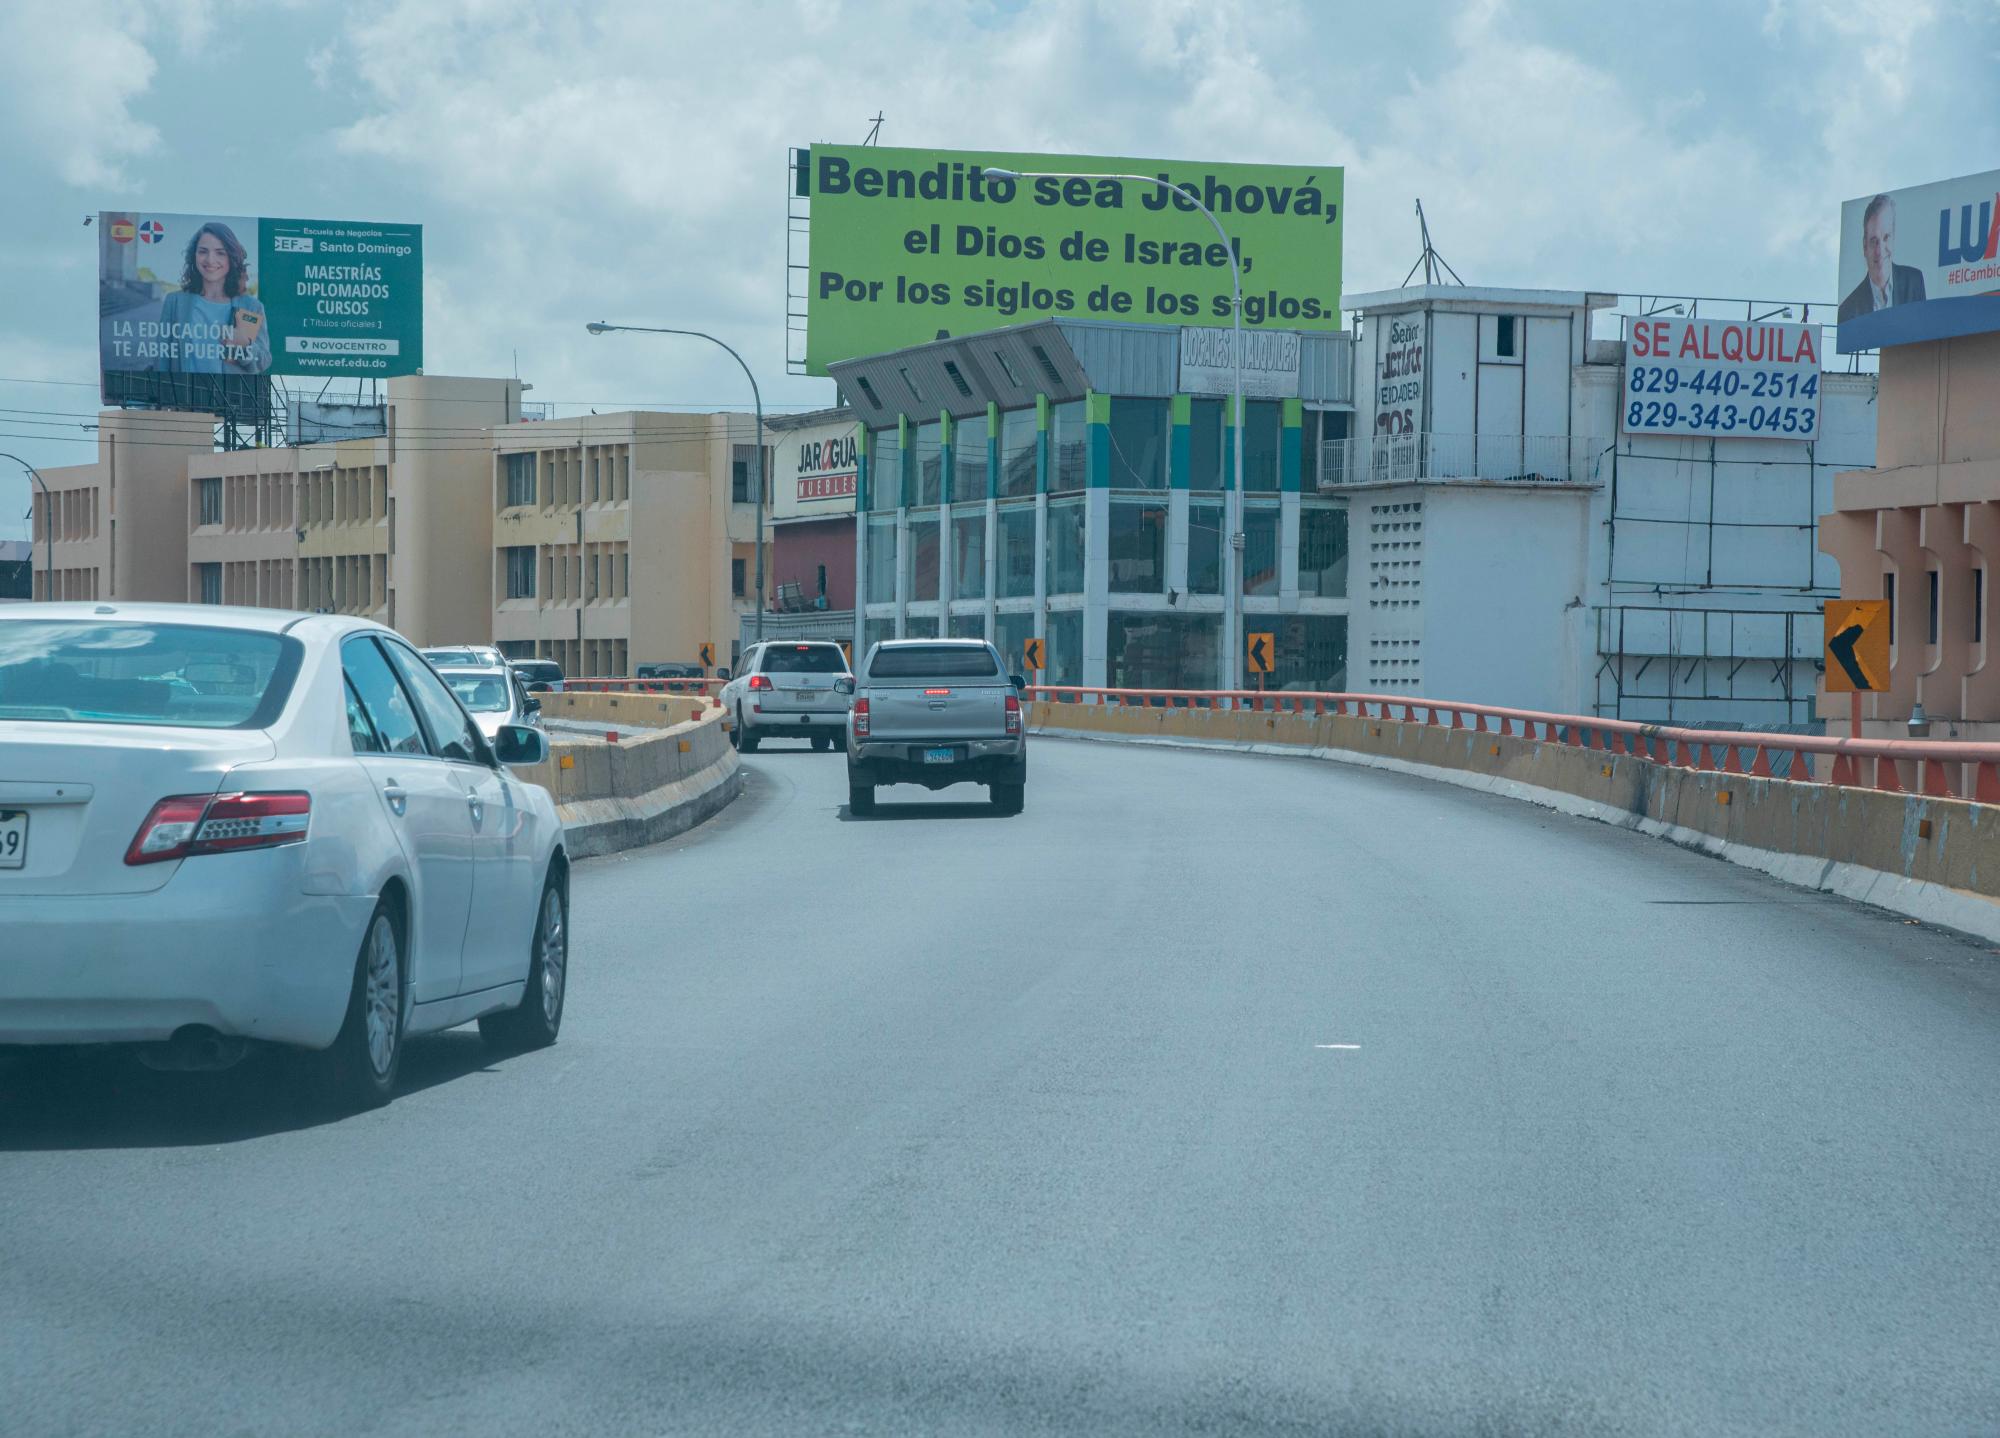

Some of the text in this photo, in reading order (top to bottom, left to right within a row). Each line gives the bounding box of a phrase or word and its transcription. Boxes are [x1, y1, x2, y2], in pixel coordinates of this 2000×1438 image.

[818, 156, 1337, 225] Bendito sea Jehová,
[303, 227, 334, 236] Escuela
[347, 229, 383, 238] Negocios
[319, 241, 355, 253] Santo
[357, 242, 412, 257] Domingo
[903, 223, 1253, 274] el Dios de Israel,
[304, 262, 382, 281] MAESTRÍAS
[296, 281, 390, 299] DIPLOMADOS
[819, 272, 884, 302] Por
[896, 276, 951, 305] los
[963, 279, 1075, 316] siglos
[1087, 284, 1133, 313] de
[1146, 286, 1200, 316] los
[316, 299, 369, 315] CURSOS
[113, 320, 234, 340] LA EDUCACIÓN
[112, 340, 259, 361] TE ABRE PUERTAS.
[312, 341, 387, 351] NOVOCENTRO
[1183, 327, 1231, 369] LOCALES
[1246, 330, 1298, 373] ALQUILER
[1632, 321, 1817, 364] SE ALQUILA
[298, 357, 387, 369] www.cef.edu.do
[1630, 367, 1818, 400] 829-440-2514
[1628, 401, 1816, 434] 829-343-0453
[798, 475, 857, 497] MUEBLES
